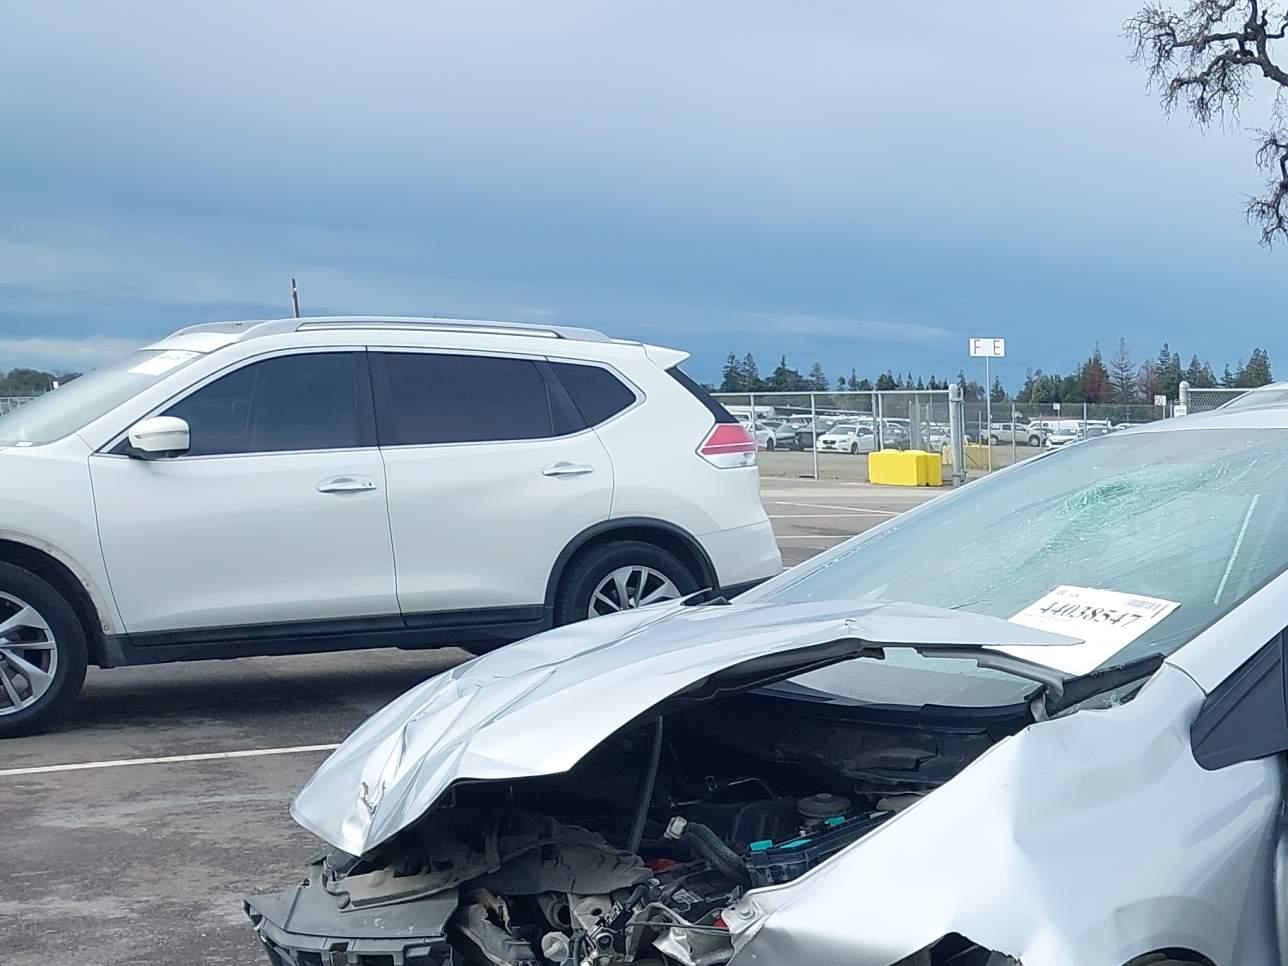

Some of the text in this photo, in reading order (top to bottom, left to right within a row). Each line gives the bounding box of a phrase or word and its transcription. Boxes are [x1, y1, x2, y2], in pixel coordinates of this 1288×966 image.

[974, 339, 1001, 355] F E
[1040, 601, 1143, 627] 44038547
